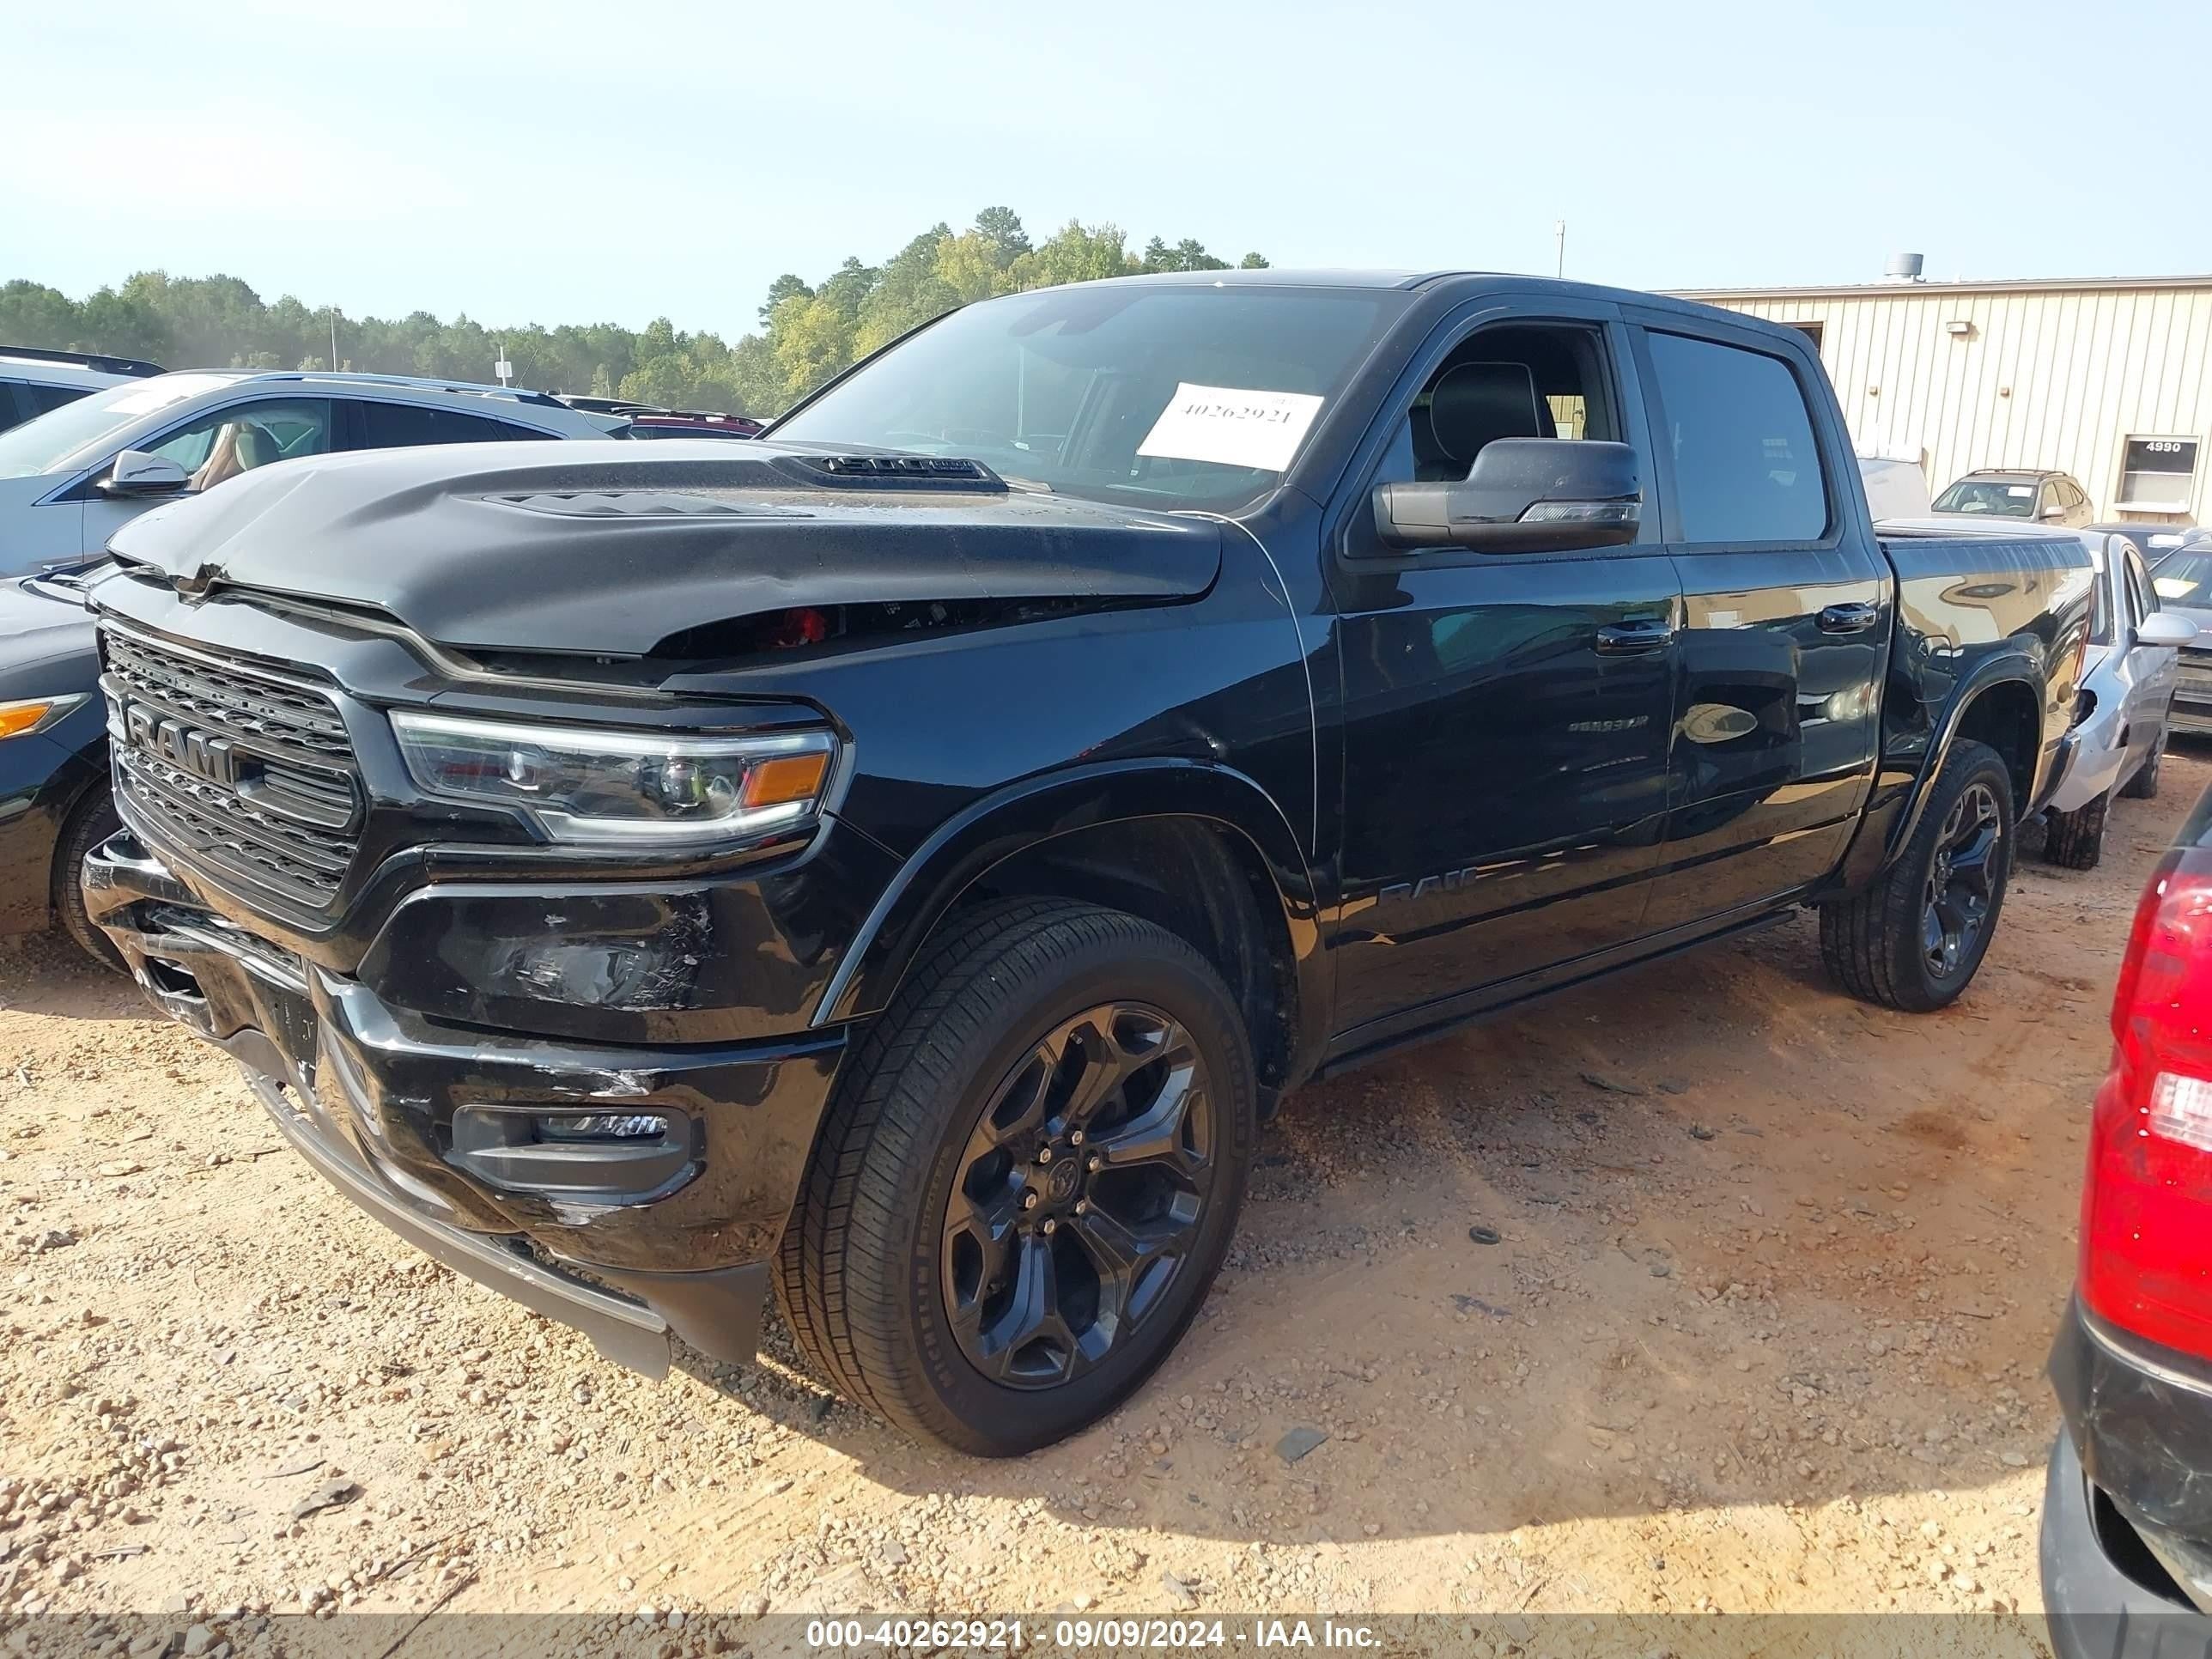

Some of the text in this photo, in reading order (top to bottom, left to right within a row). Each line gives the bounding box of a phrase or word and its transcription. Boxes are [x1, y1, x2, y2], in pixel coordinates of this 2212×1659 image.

[1183, 404, 1291, 423] 40262921
[2146, 441, 2182, 453] 4990
[127, 704, 234, 786] RAM
[1379, 866, 1478, 905] RAM
